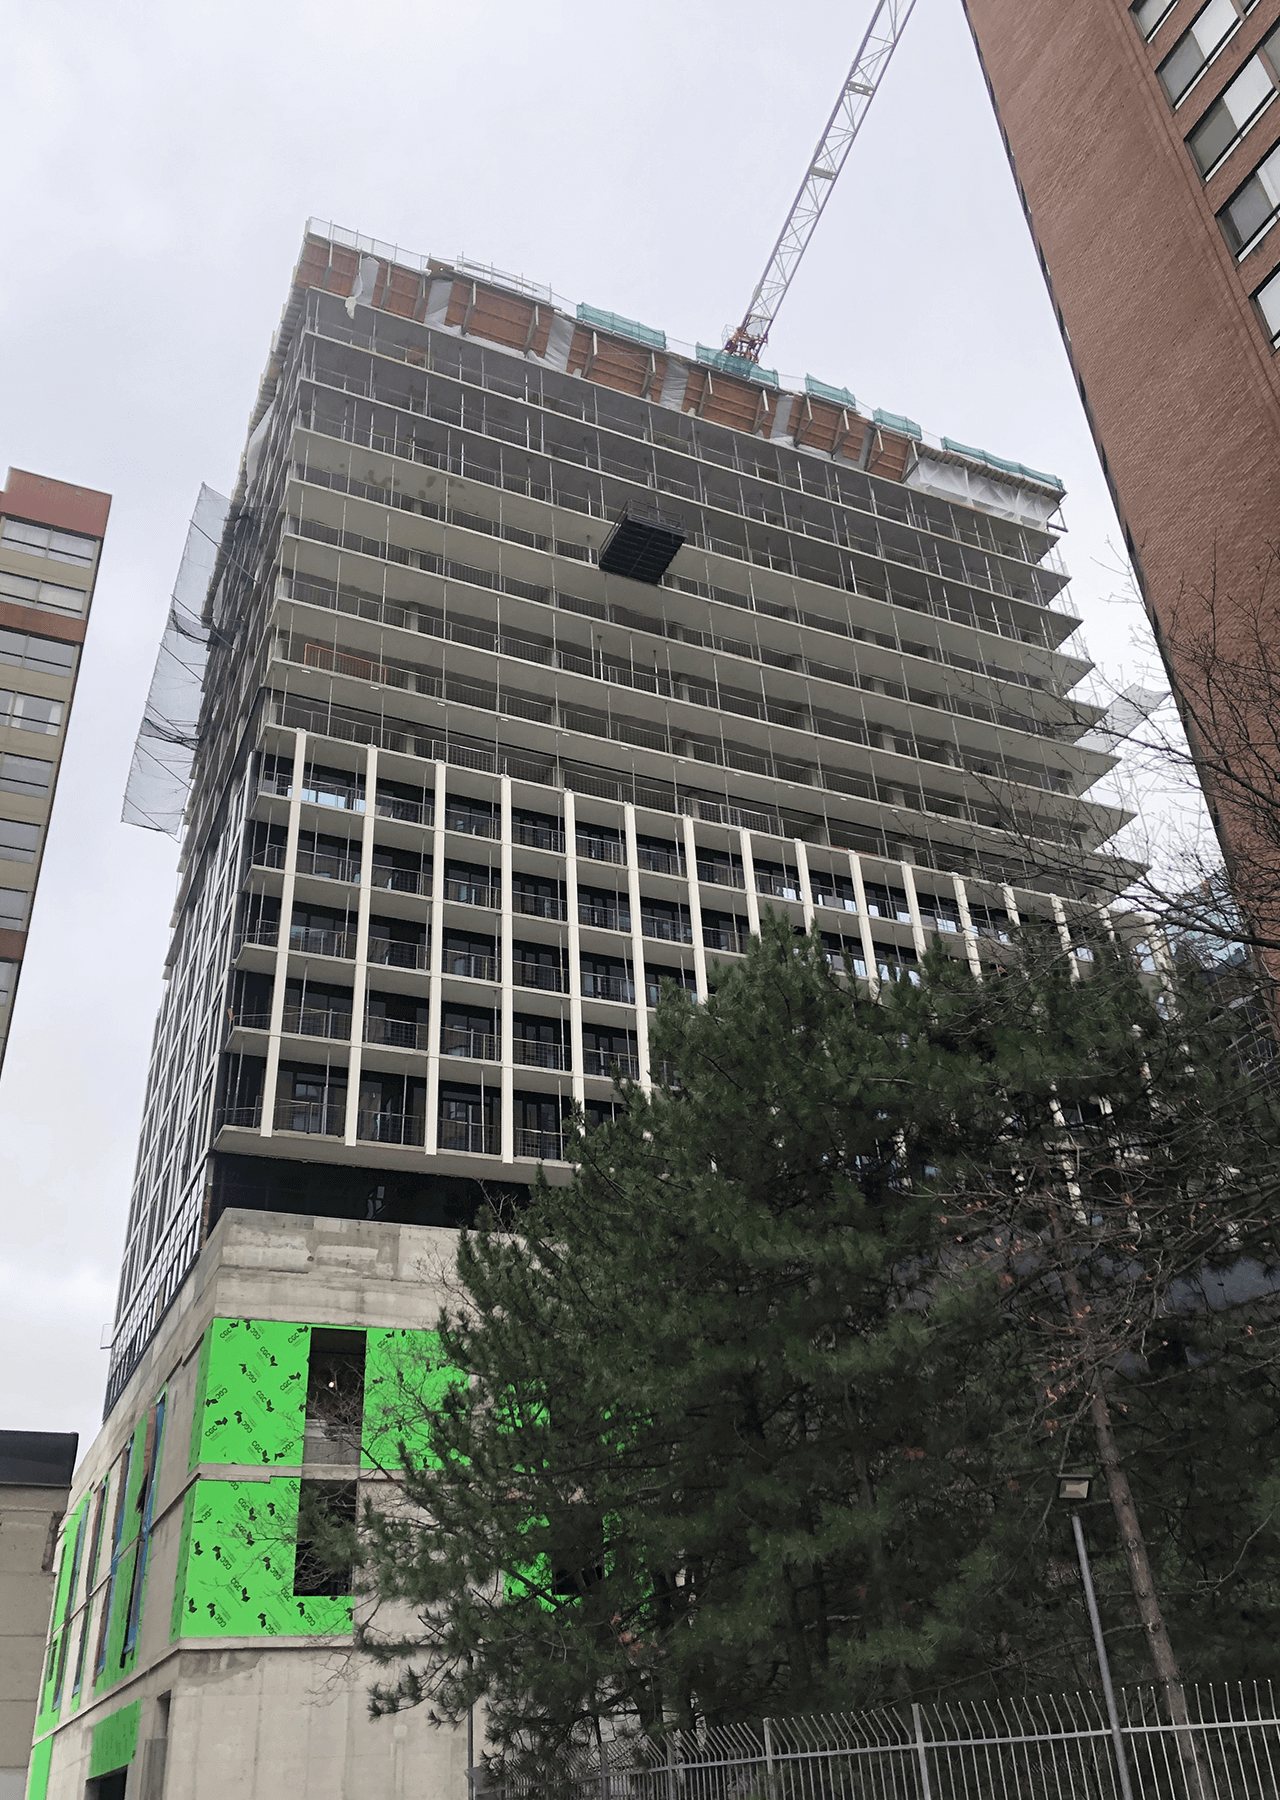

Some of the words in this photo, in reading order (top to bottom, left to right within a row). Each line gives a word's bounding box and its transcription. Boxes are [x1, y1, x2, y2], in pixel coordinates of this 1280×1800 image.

[220, 1327, 232, 1339] CGC
[250, 1327, 261, 1340] CGC
[288, 1333, 300, 1344] CGC
[260, 1346, 271, 1359] CGC
[246, 1371, 257, 1383] CGC
[280, 1380, 292, 1391] CGC
[215, 1388, 228, 1399] CGC
[256, 1390, 267, 1403] CGC
[205, 1425, 217, 1437] CGC
[241, 1421, 253, 1433] CGC
[251, 1441, 262, 1453] CGC
[282, 1441, 294, 1452] CGC
[238, 1498, 249, 1511] CGC
[220, 1556, 232, 1570] CGC
[230, 1578, 242, 1592] CGC
[281, 1588, 292, 1602] CGC
[215, 1615, 226, 1627] CGC
[304, 1613, 316, 1626] CGC
